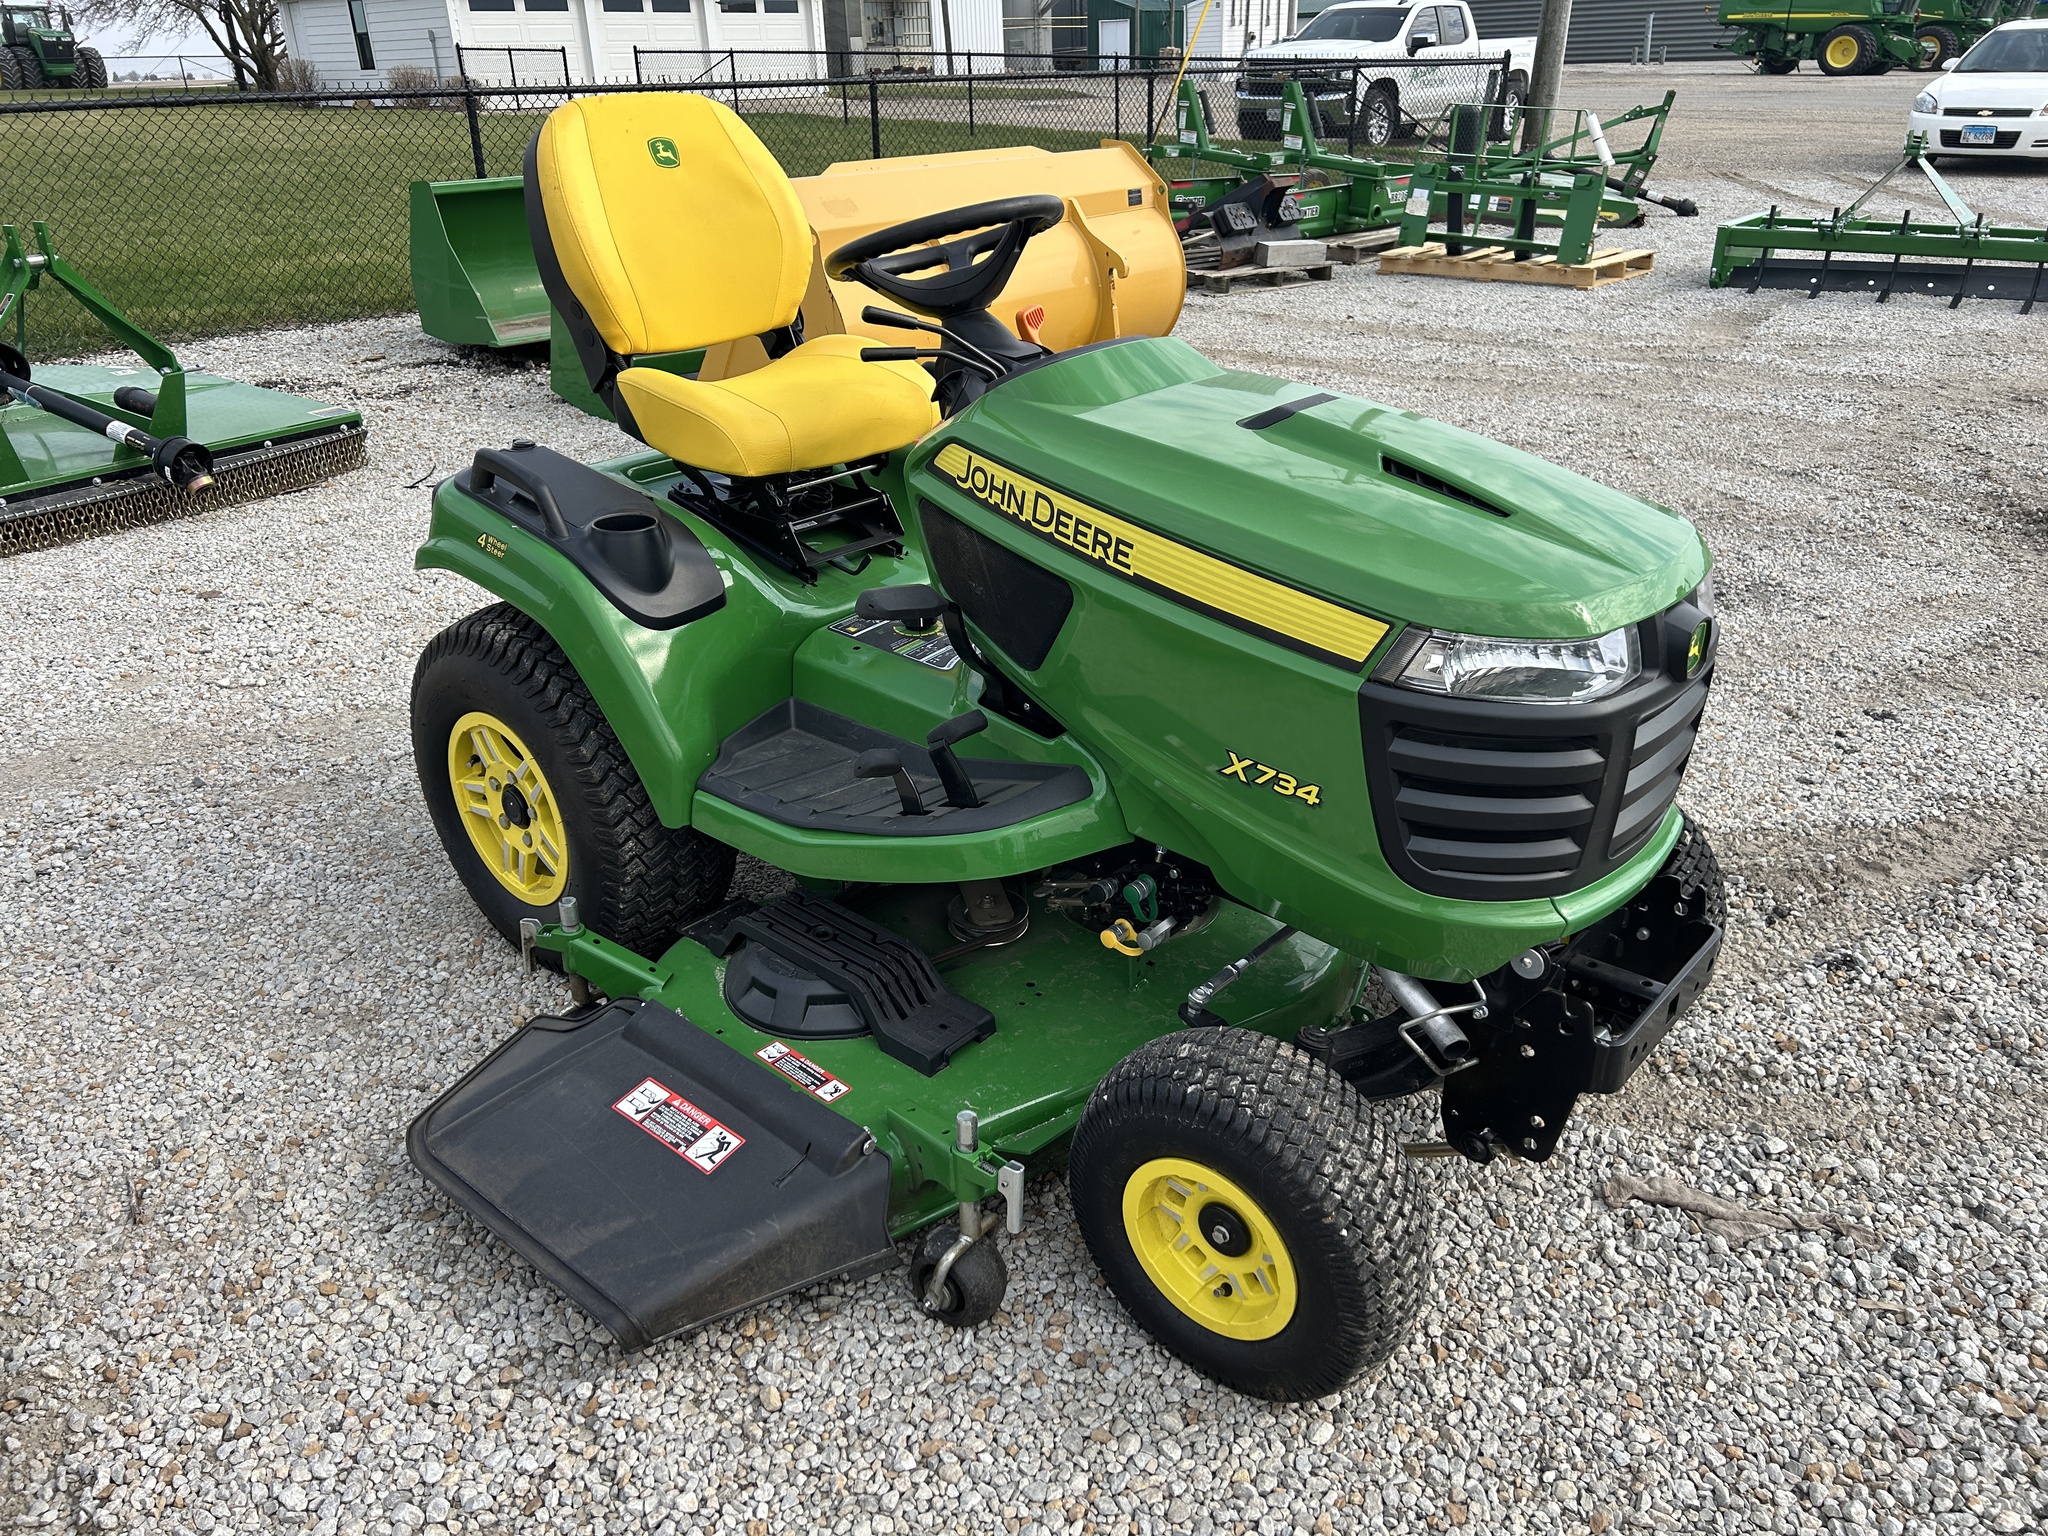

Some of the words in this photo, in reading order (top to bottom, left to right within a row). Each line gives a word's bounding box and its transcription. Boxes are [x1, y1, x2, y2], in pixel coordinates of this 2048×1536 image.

[955, 454, 1026, 518] JOHN
[1030, 491, 1135, 573] DEERE
[477, 534, 486, 548] 4
[488, 535, 508, 551] Wheel
[486, 543, 505, 558] Steer
[1218, 749, 1322, 806] X734
[804, 1060, 825, 1074] DANGER
[680, 1102, 712, 1126] DANGER
